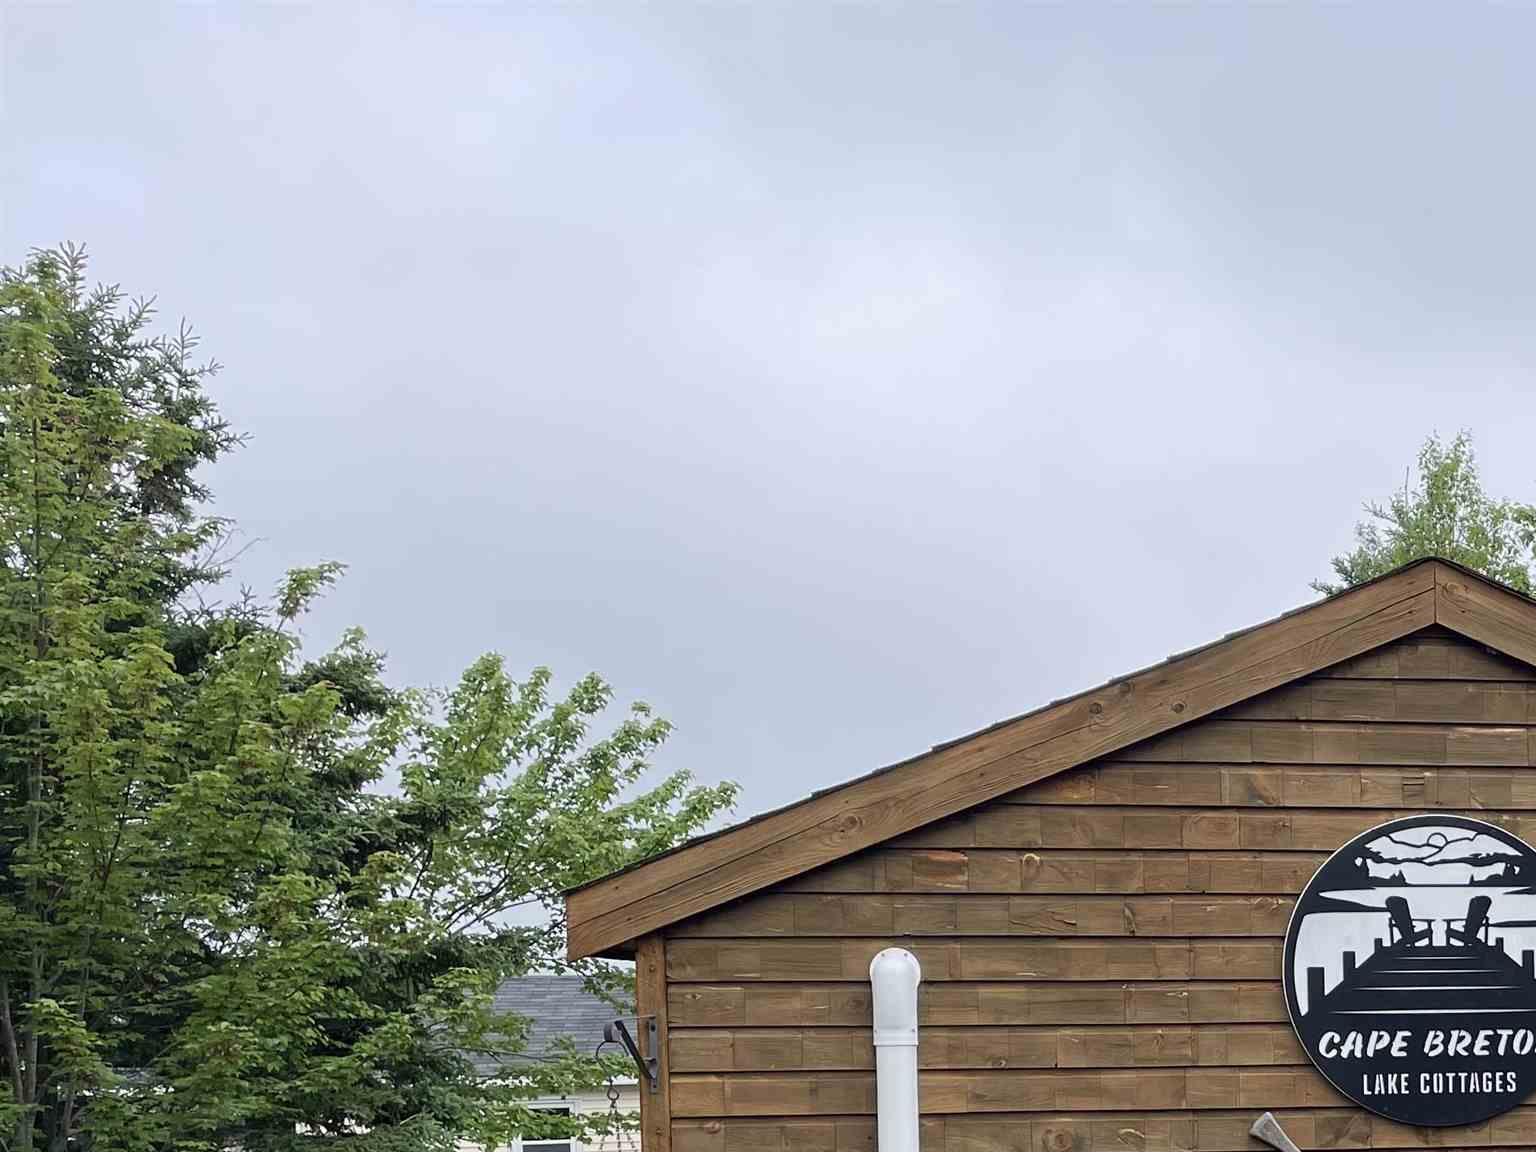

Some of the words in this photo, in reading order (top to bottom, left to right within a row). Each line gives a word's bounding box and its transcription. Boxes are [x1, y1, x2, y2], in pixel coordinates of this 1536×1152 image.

[1318, 1030, 1412, 1059] CAPE
[1363, 1073, 1410, 1096] LAKE
[1420, 1071, 1517, 1094] COTTAGES
